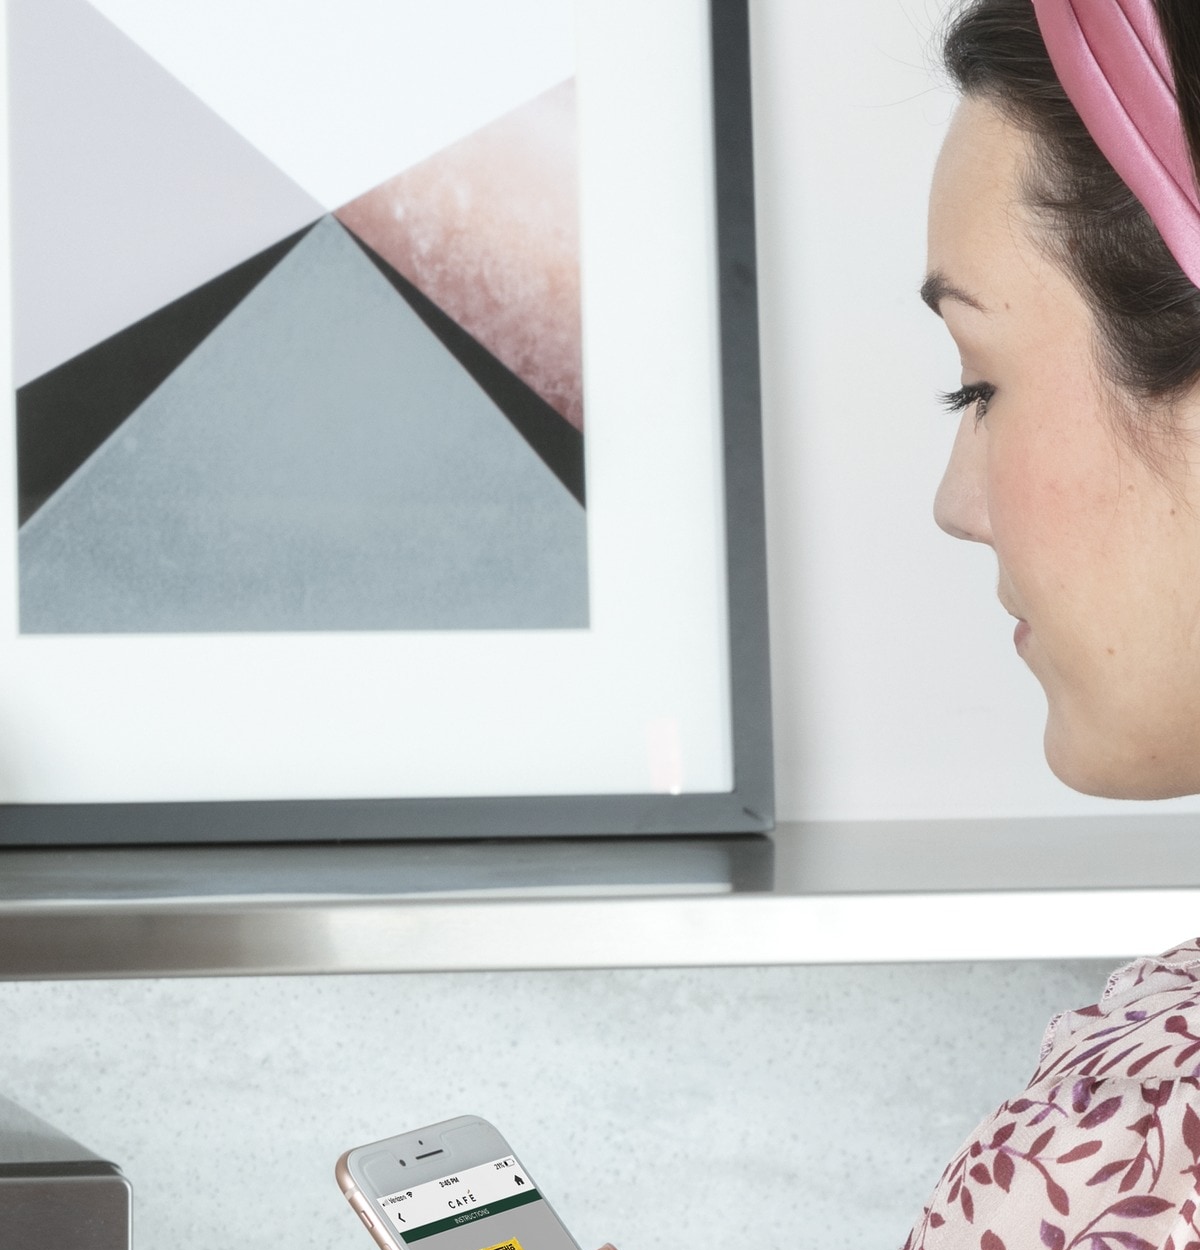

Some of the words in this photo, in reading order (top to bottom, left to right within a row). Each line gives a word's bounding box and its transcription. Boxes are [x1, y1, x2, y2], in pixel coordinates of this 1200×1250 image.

[388, 1195, 407, 1204] Verizon
[439, 1179, 451, 1188] 3:45
[448, 1190, 476, 1209] CAFÉ
[454, 1208, 490, 1224] INSTRUCTIONS
